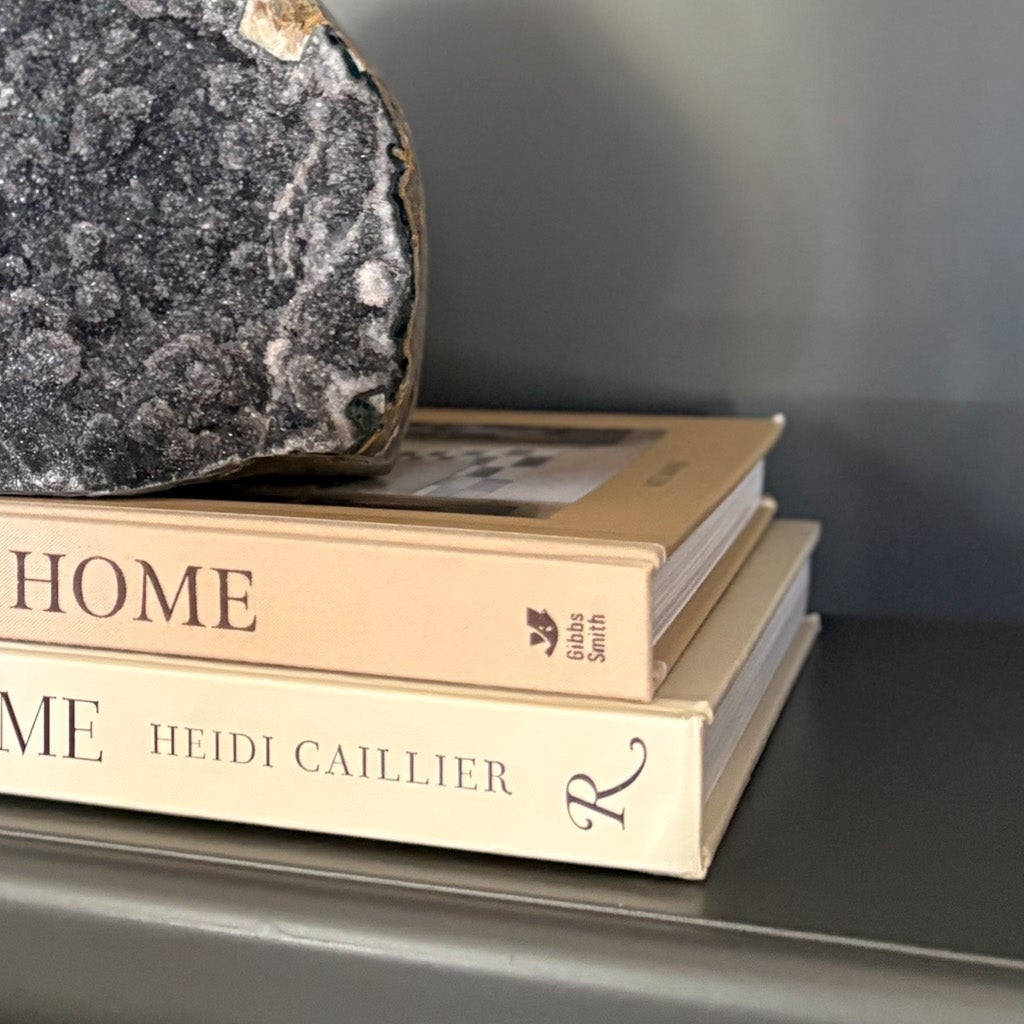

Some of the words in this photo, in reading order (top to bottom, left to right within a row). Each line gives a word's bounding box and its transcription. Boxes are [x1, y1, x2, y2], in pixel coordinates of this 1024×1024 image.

[9, 549, 258, 633] HOME
[566, 612, 585, 662] Gibbs
[587, 613, 606, 664] Smith
[150, 722, 274, 769] HEIDI
[294, 739, 513, 796] CAILLIER
